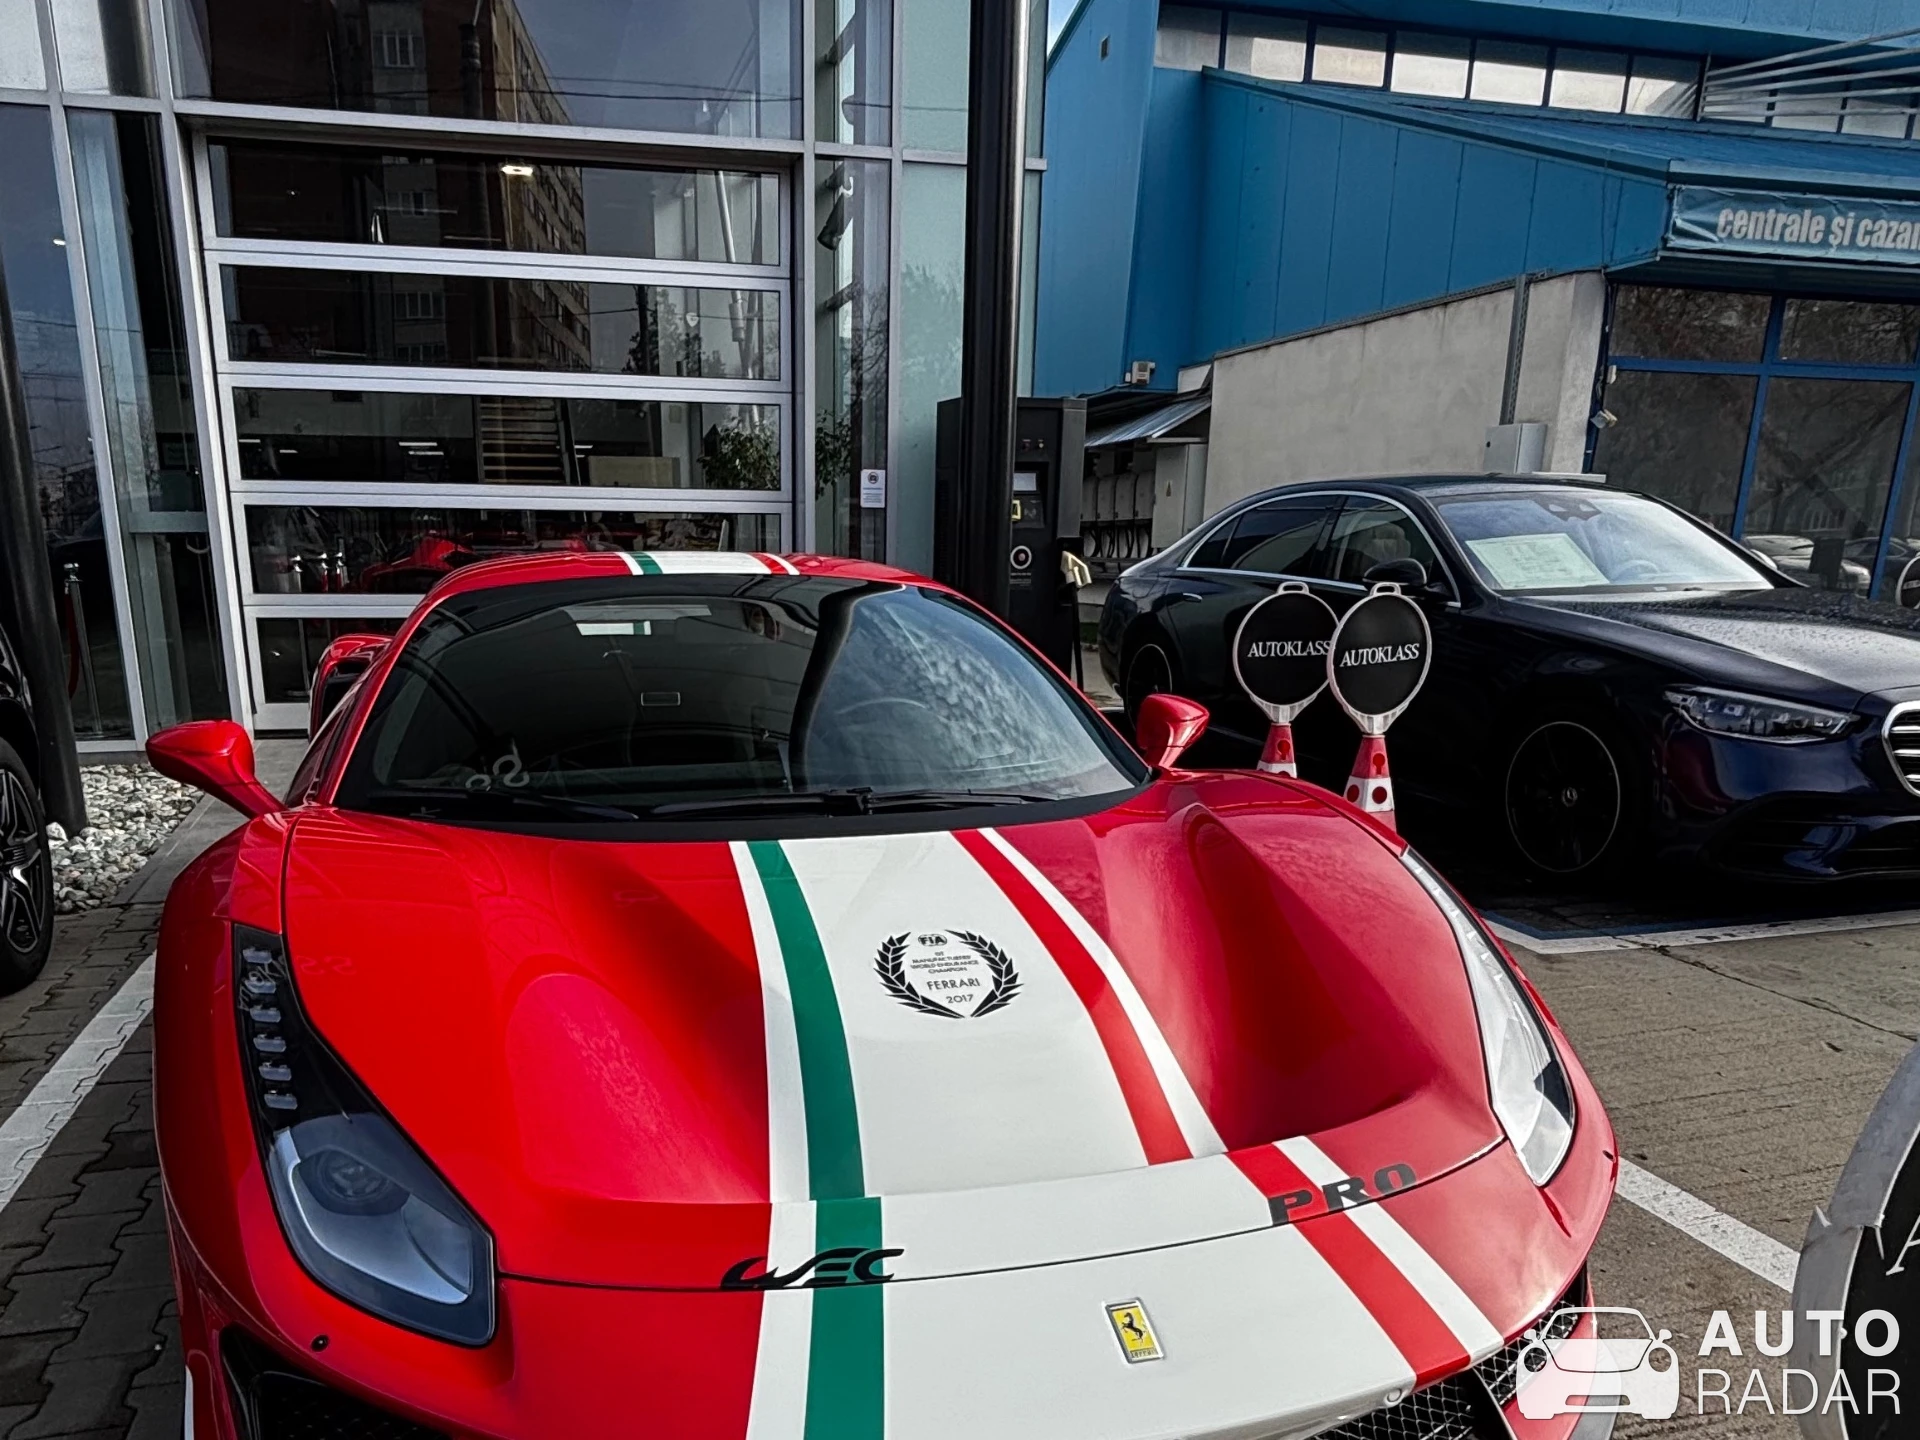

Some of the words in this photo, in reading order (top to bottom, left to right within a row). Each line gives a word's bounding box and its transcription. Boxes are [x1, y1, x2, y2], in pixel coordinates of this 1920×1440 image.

[1717, 208, 1826, 244] centrale
[1247, 640, 1331, 657] AUTOKLASS
[1340, 643, 1420, 667] AUTOKLASS
[919, 936, 946, 945] FIA
[926, 977, 981, 990] FERRARI
[946, 994, 973, 1003] 2017
[1267, 1163, 1417, 1226] PRO
[720, 1247, 905, 1290] WEC
